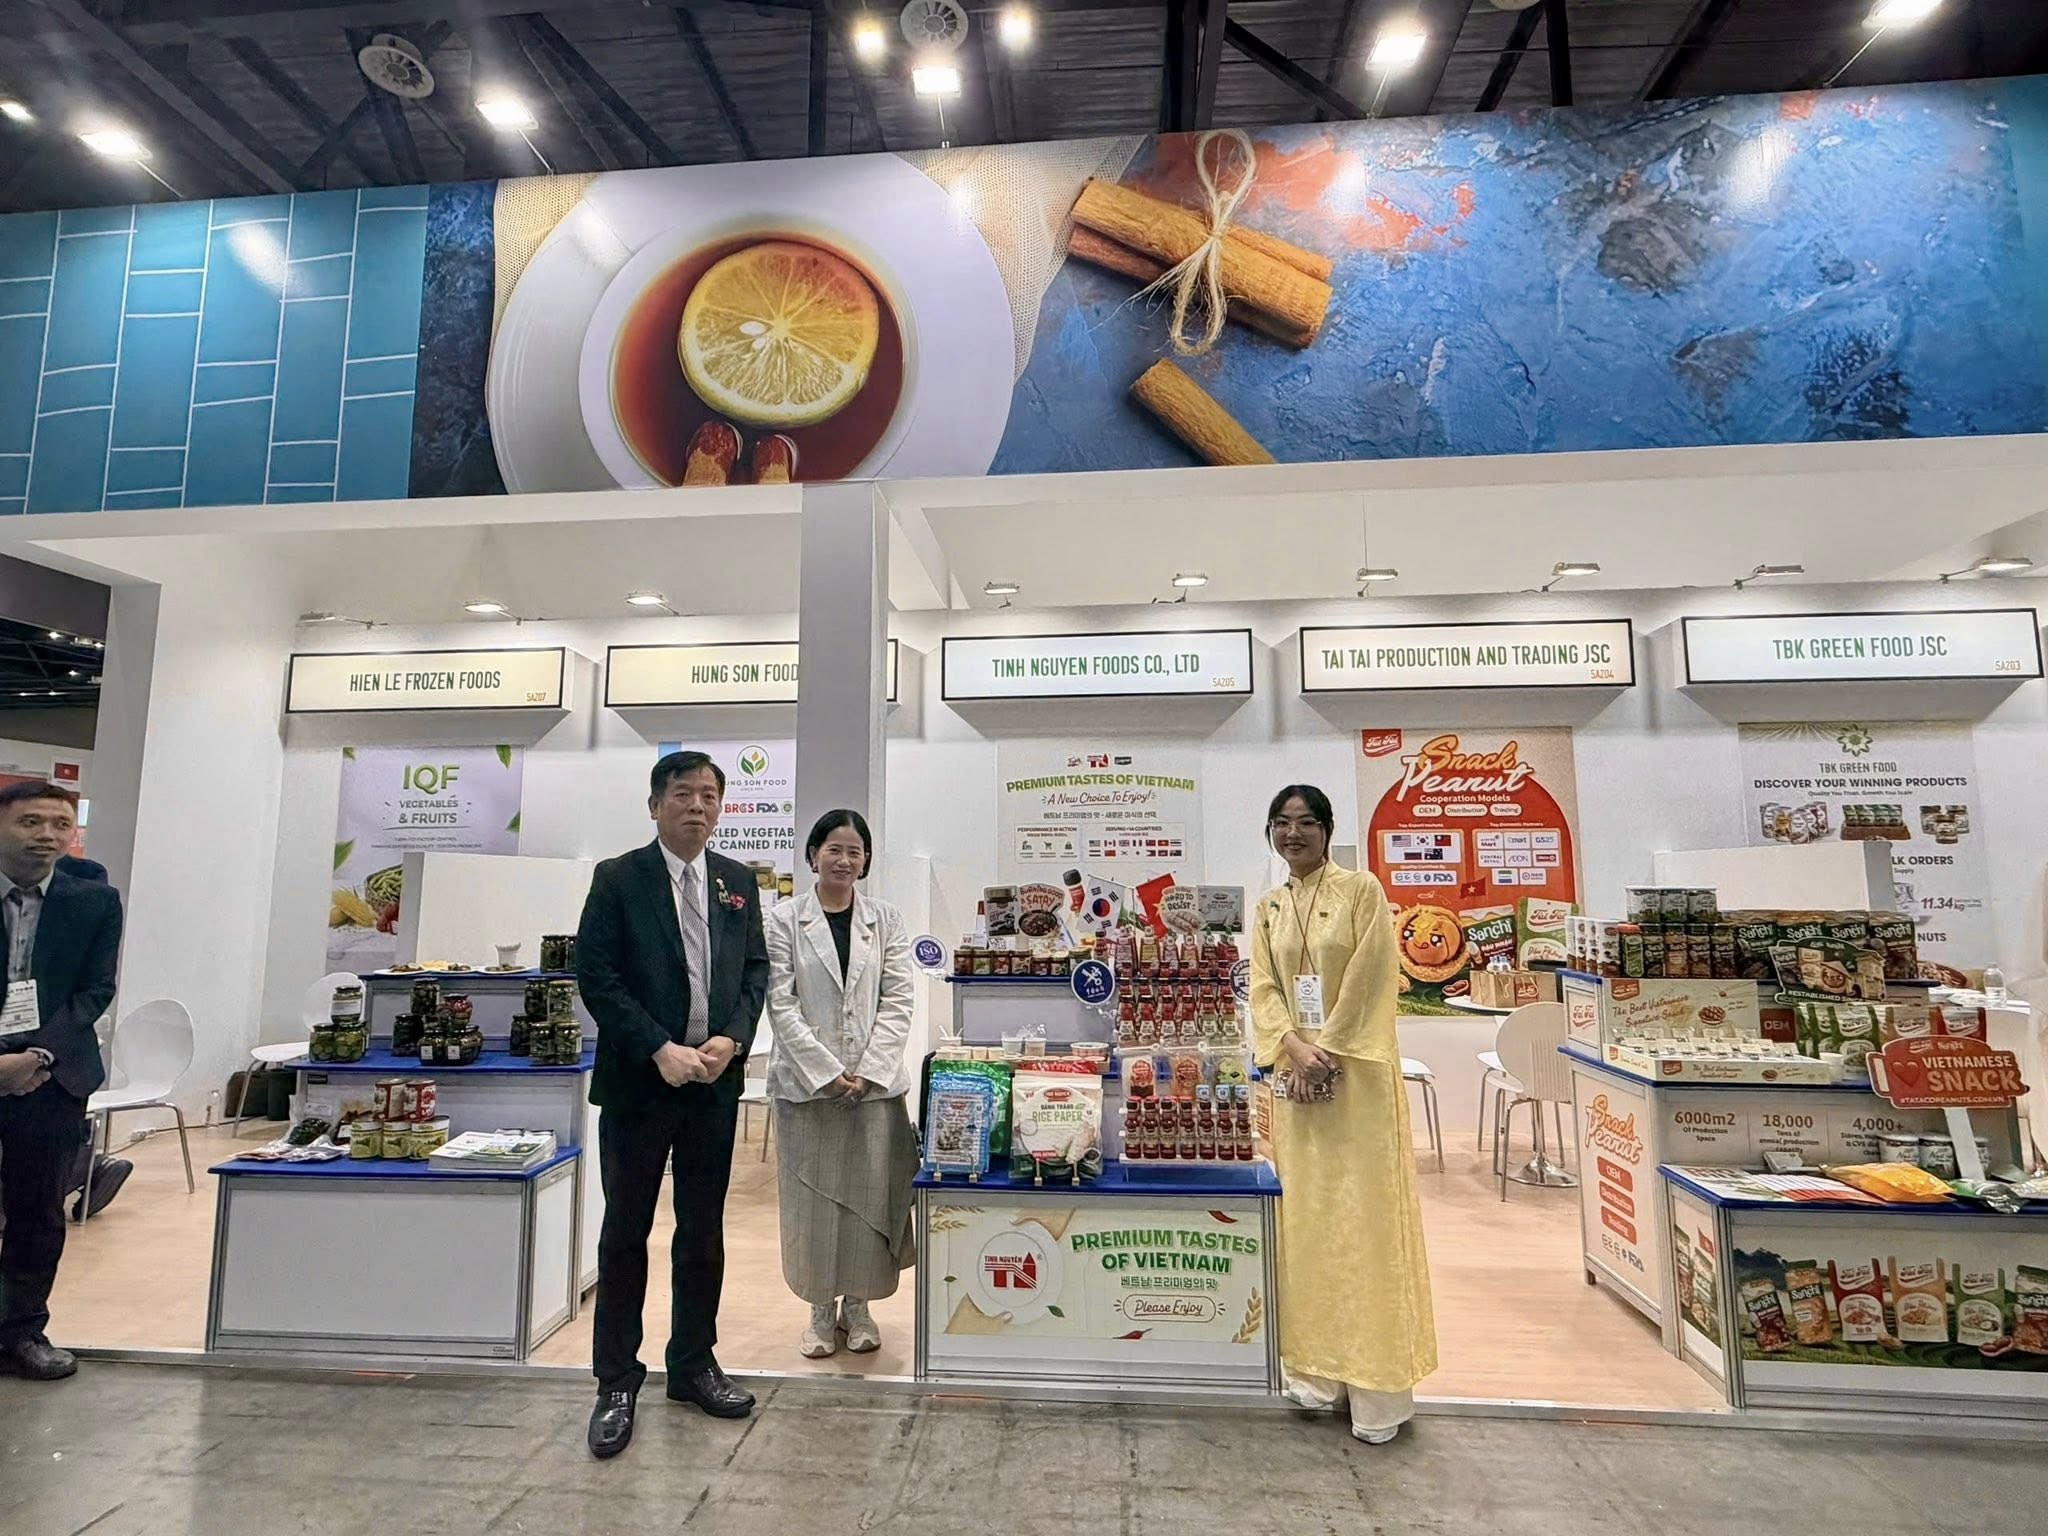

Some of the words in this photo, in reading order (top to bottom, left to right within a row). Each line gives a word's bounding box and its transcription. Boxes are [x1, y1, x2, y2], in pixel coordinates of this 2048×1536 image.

[1772, 638, 1806, 660] TBK
[1810, 636, 1865, 659] GREEN
[1871, 635, 1914, 658] FOOD
[1918, 634, 1948, 657] JSC
[1322, 649, 1344, 670] TAI
[1348, 648, 1371, 669] TAI
[1376, 646, 1471, 668] PRODUCTION
[1476, 645, 1508, 667] AND
[1511, 644, 1579, 666] TRADING
[1583, 643, 1611, 664] JSC
[992, 658, 1025, 678] TINH
[1030, 656, 1087, 676] NGUYEN
[1093, 655, 1140, 675] FOODS
[1144, 654, 1170, 676] CO.,
[1174, 653, 1200, 673] LTD
[350, 673, 380, 691] HIEN
[385, 672, 401, 691] LE
[405, 671, 454, 690] FROZEN
[459, 670, 501, 689] FOODS
[691, 665, 728, 684] HUNG
[732, 664, 759, 683] SON
[764, 663, 799, 682] FOOD
[1418, 734, 1519, 771] Snack
[1819, 763, 1837, 774] TBK
[1840, 762, 1870, 774] GREEN
[1873, 762, 1897, 773] FOOD
[403, 765, 460, 795] IQF
[1006, 775, 1066, 793] PREMIUM
[1067, 773, 1114, 786] TASTES
[1115, 774, 1134, 785] OF
[1135, 775, 1195, 791] VIETNAM
[1395, 755, 1535, 801] Peanut
[1754, 779, 1812, 789] DISCOVER
[1814, 778, 1847, 788] YOUR
[1850, 777, 1902, 788] WINNING
[1905, 776, 1968, 787] PRODUCTS
[400, 799, 459, 808] VEGETABLES
[1047, 793, 1055, 805] A
[1057, 792, 1078, 804] New
[1079, 791, 1110, 804] Choice
[1111, 790, 1121, 803] To
[1122, 789, 1152, 804] Enjoy!
[1419, 794, 1477, 804] Cooperation
[1478, 793, 1511, 802] Models
[756, 803, 779, 813] FDA
[1418, 806, 1437, 814] OEM
[1446, 806, 1486, 814] Distribution
[1493, 806, 1519, 815] Trading
[398, 813, 408, 824] &
[411, 812, 457, 824] FRUITS
[711, 828, 739, 838] KLED
[743, 827, 795, 838] VEGETAB
[720, 840, 770, 850] CANNED
[774, 840, 795, 850] FRU
[1891, 856, 1905, 865] LK
[1908, 855, 1954, 866] ORDERS
[1433, 873, 1454, 882] FDA
[1921, 897, 1953, 909] 11.34
[1953, 902, 1966, 912] kg
[1467, 918, 1513, 942] Sanchi
[1738, 924, 1774, 939] Sanchi
[1831, 923, 1867, 939] Sanchi
[1874, 921, 1913, 939] Sanchi
[1917, 932, 1947, 942] NUTS
[919, 945, 939, 957] ISO
[1763, 1020, 1791, 1030] OEM
[1922, 1055, 2013, 1069] VIETNAMESE
[1927, 1069, 2020, 1092] SNACK
[1032, 1111, 1052, 1122] RICE
[1054, 1110, 1083, 1122] PAPER
[1592, 1094, 1634, 1141] Snack
[1674, 1111, 1736, 1126] 6000m2
[1763, 1114, 1813, 1129] 18,000
[1853, 1117, 1905, 1132] 4,000+
[1585, 1105, 1643, 1164] Peanut
[1606, 1165, 1621, 1182] OEM
[1071, 1229, 1173, 1251] PREMIUM
[1176, 1230, 1260, 1254] TASTES
[1101, 1253, 1130, 1270] OF
[1133, 1251, 1232, 1274] VIETNAM
[1120, 1276, 1151, 1288] 베트남
[1153, 1276, 1205, 1289] 프리미엄의
[1206, 1278, 1218, 1290] 맛
[1134, 1299, 1171, 1314] Please
[1172, 1299, 1203, 1316] Enjoy
